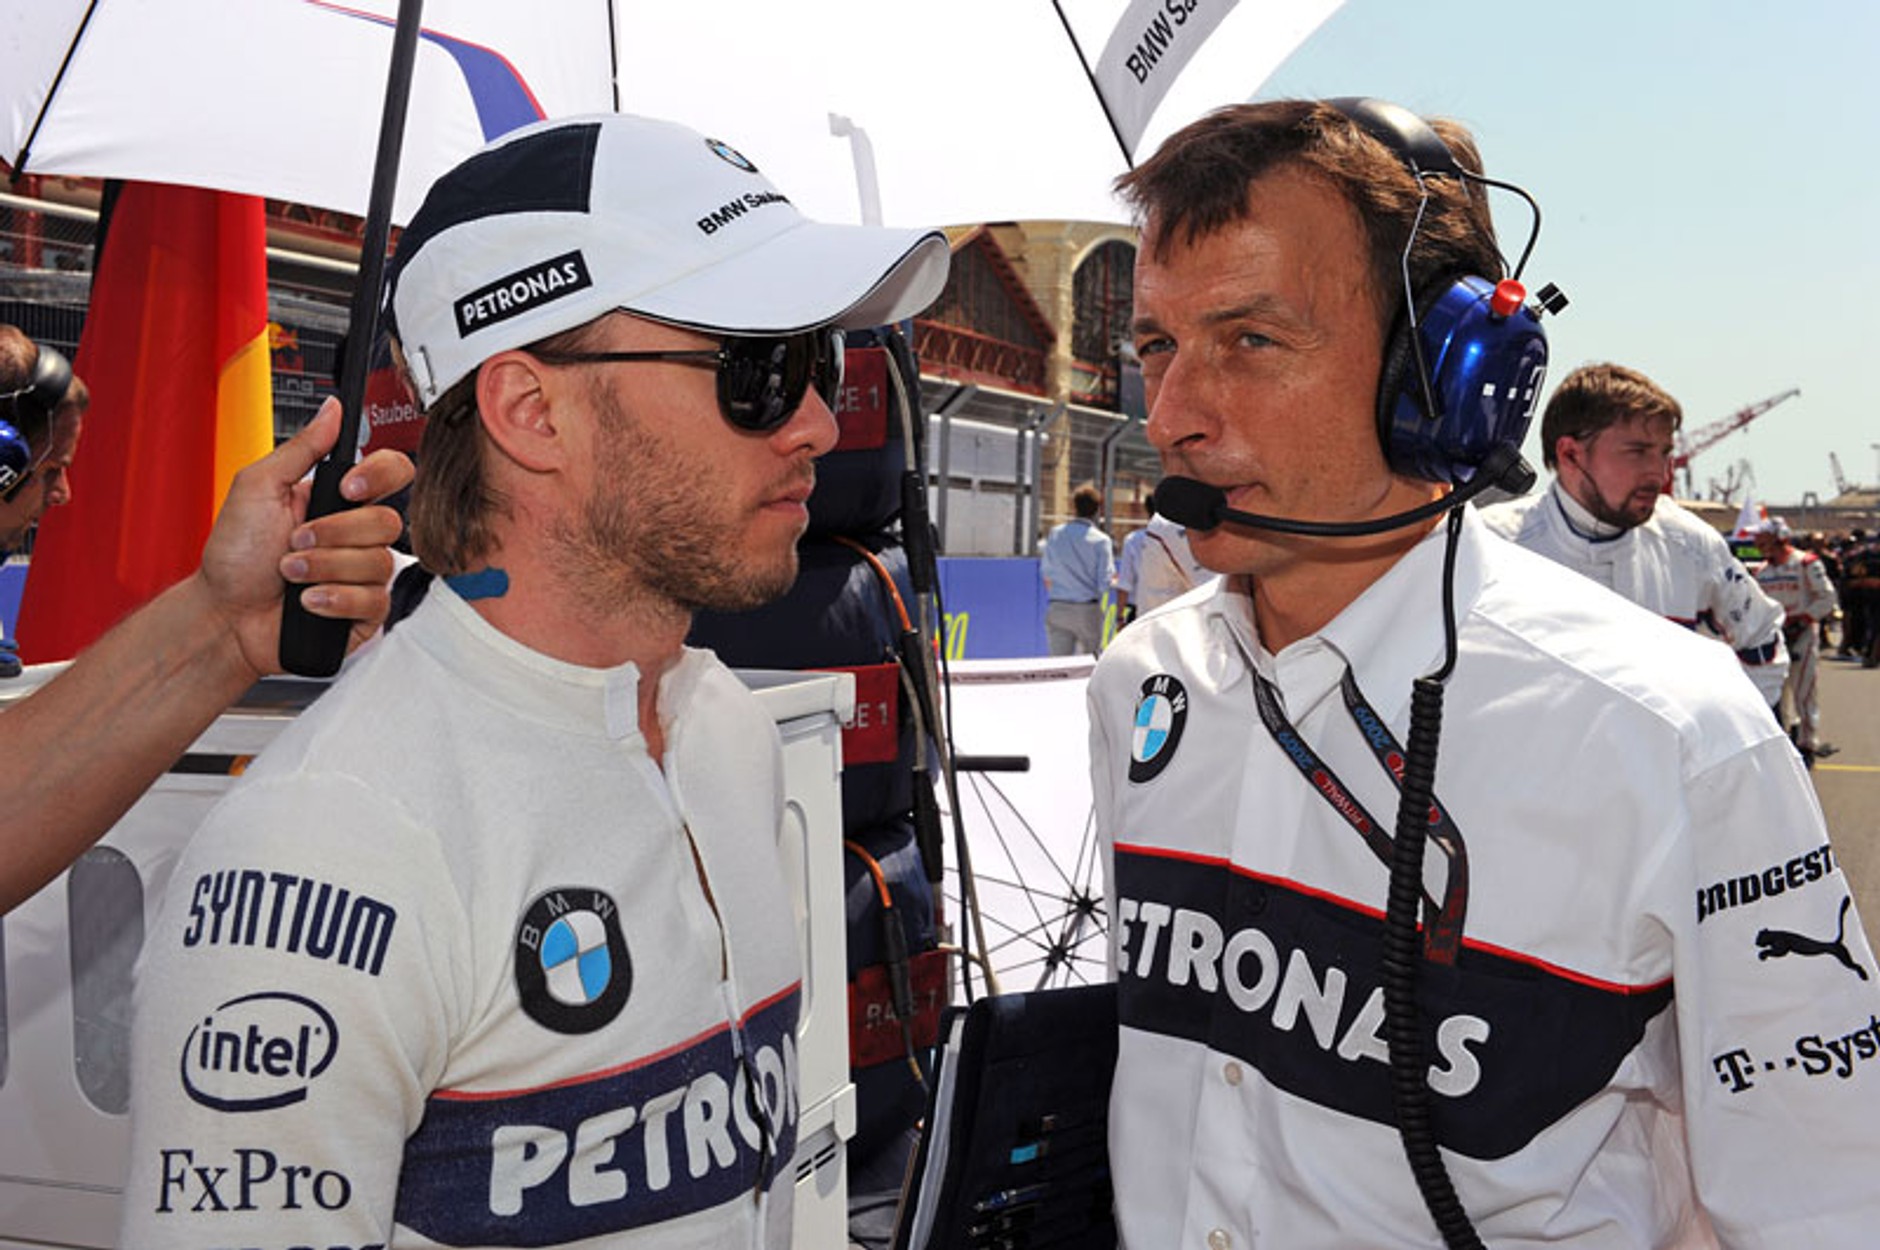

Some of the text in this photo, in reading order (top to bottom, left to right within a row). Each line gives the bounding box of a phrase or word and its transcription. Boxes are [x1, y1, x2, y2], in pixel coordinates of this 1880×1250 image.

[1125, 9, 1174, 85] BMW
[697, 198, 749, 236] BMW
[461, 261, 580, 328] PETRONAS
[182, 869, 398, 977] SYNTIUM
[519, 892, 616, 952] BMW
[1119, 897, 1492, 1098] ETRONAS
[199, 1016, 311, 1078] intel
[154, 1148, 353, 1214] FxPro
